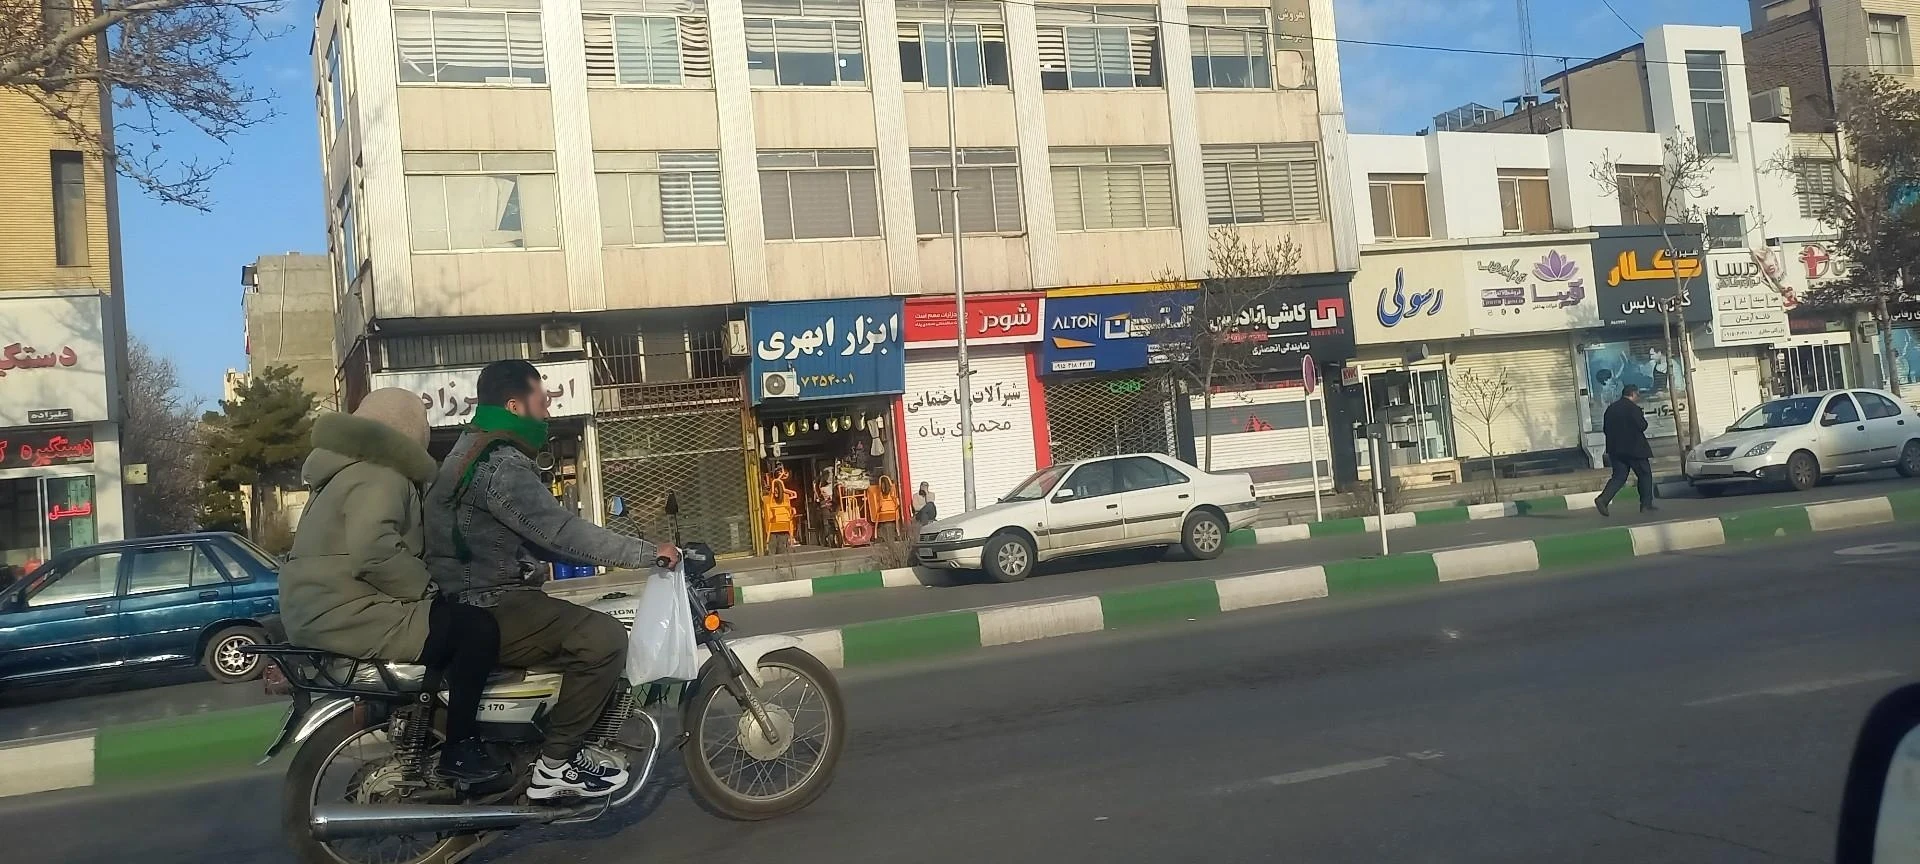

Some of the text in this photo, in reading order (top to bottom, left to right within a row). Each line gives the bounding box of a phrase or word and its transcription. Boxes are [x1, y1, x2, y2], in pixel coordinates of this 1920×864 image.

[1715, 260, 1759, 278] درسا
[1377, 266, 1444, 328] رسولی
[1622, 295, 1656, 314] نایس
[1052, 313, 1098, 331] ALTON
[1267, 301, 1307, 331] کاشی
[757, 312, 899, 361] ابزار ابهری
[20, 435, 95, 467] دستگیره
[488, 702, 505, 712] 170
